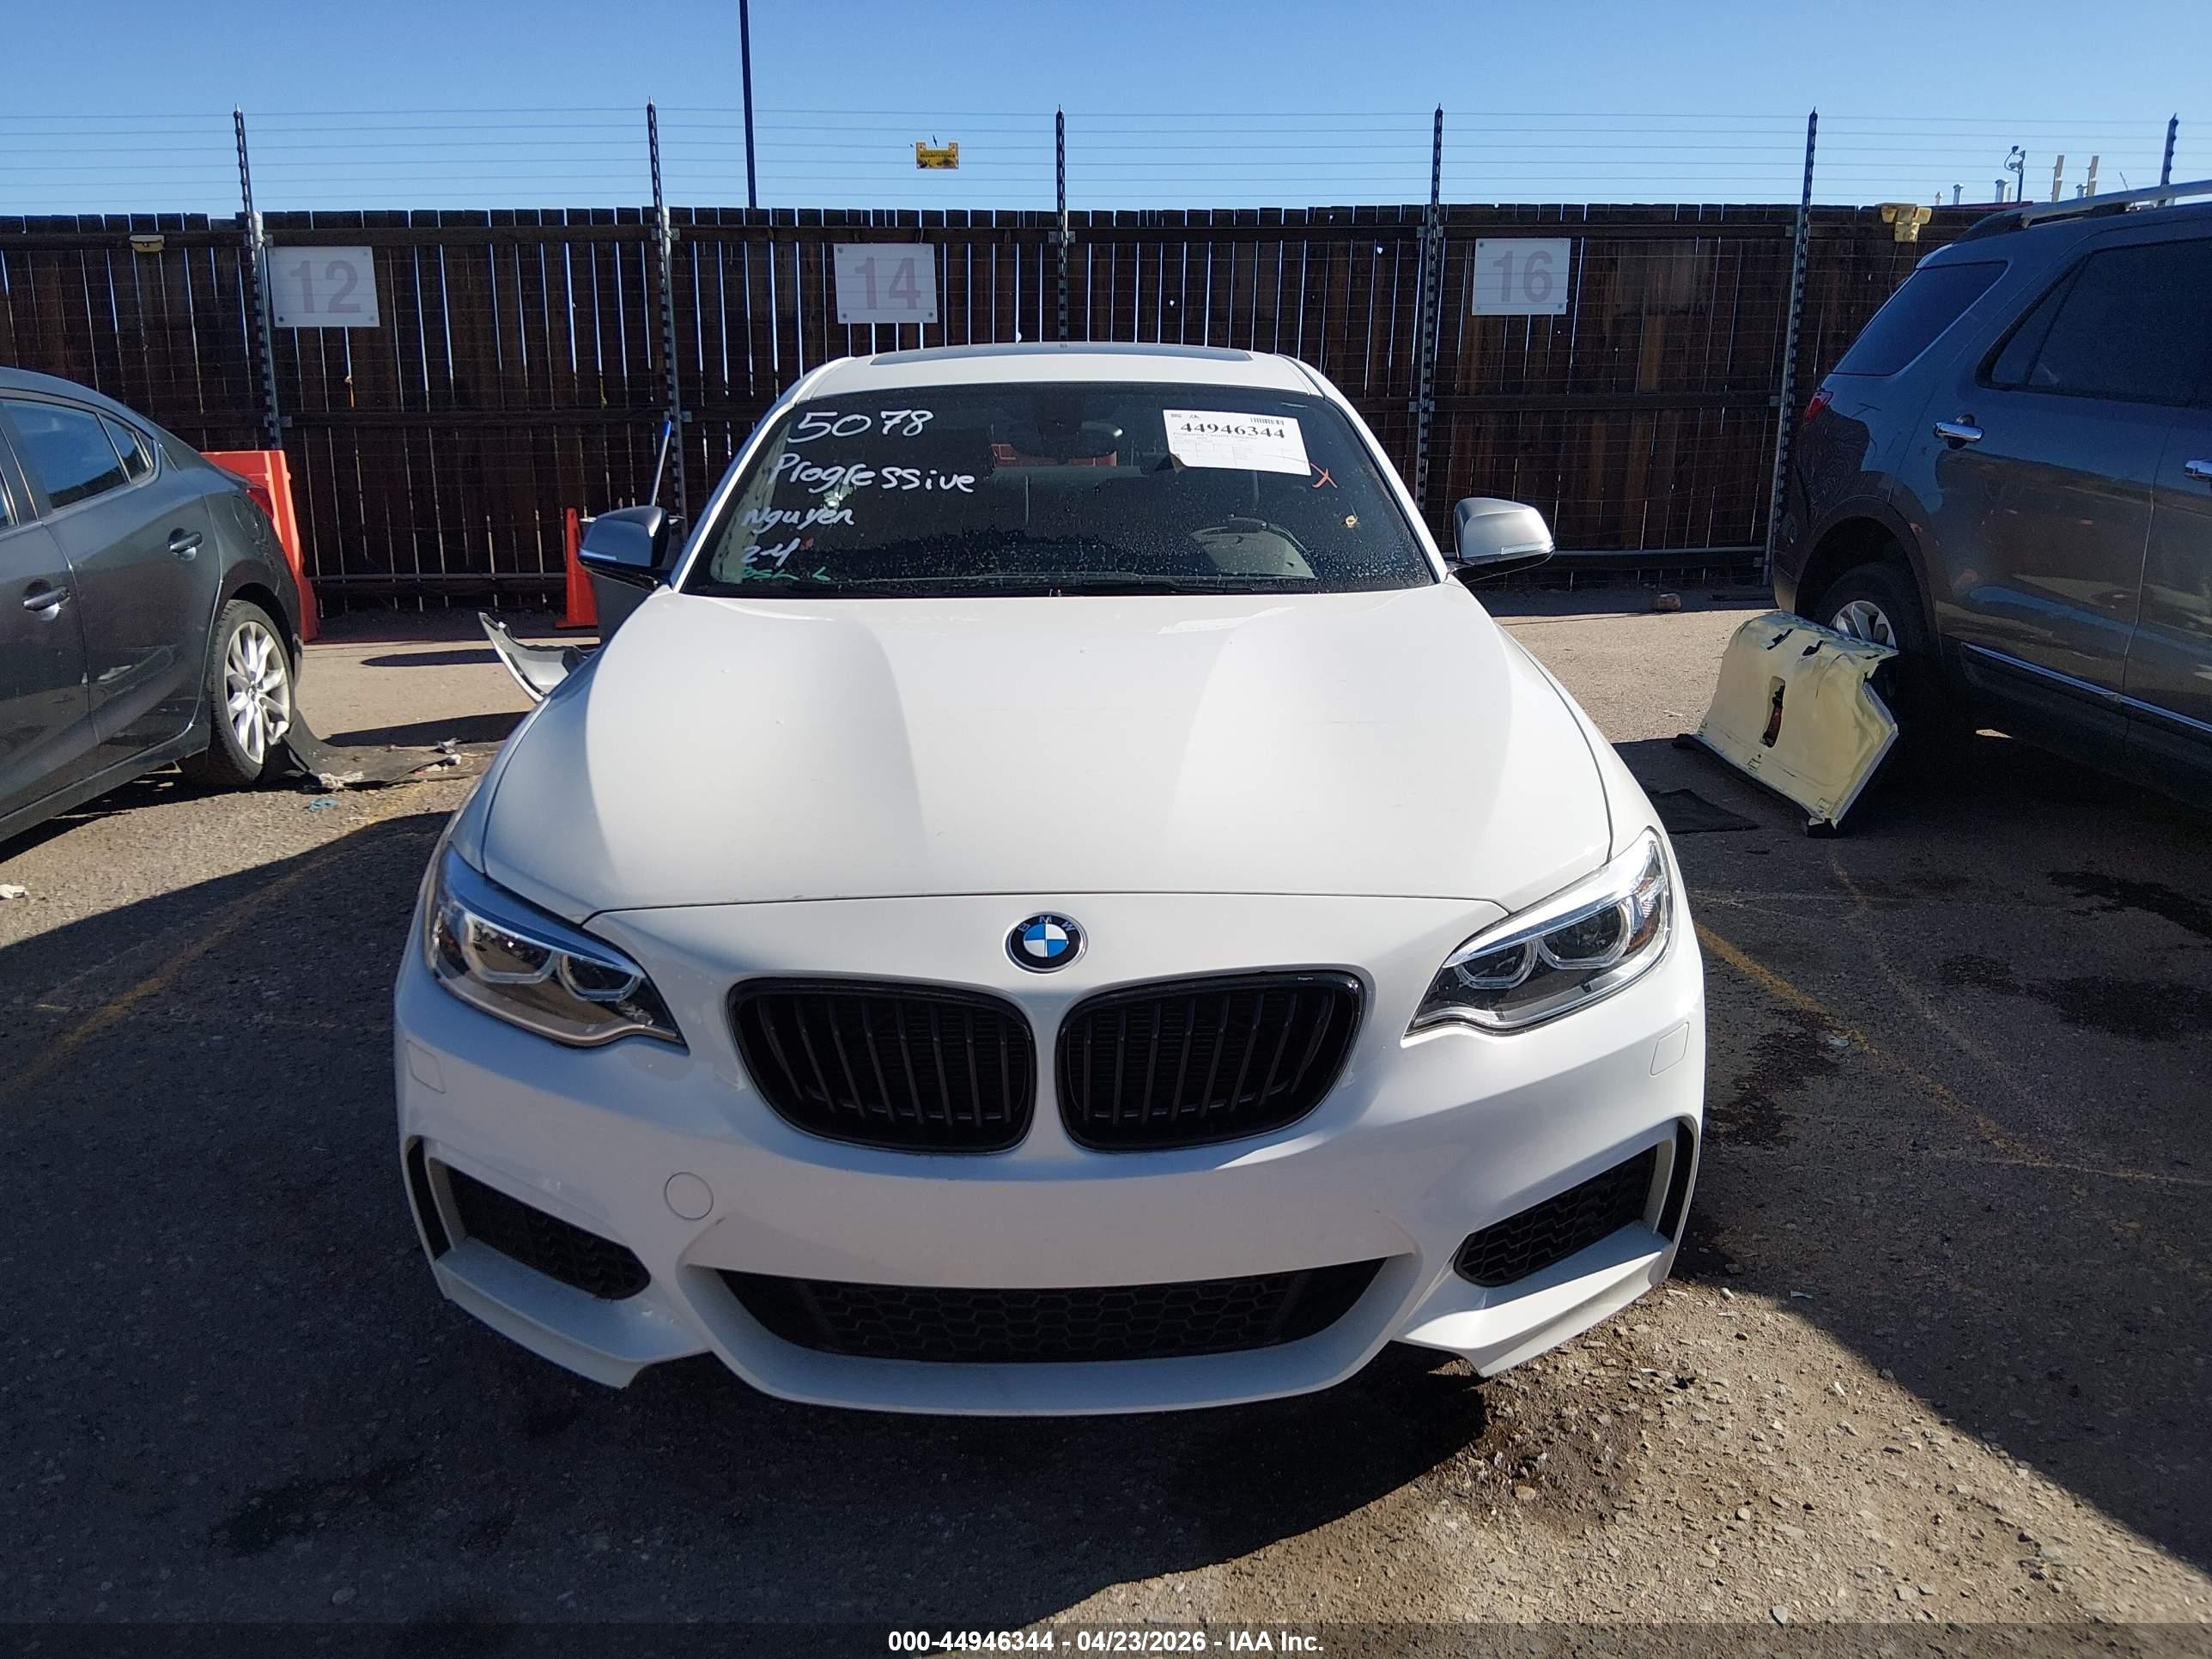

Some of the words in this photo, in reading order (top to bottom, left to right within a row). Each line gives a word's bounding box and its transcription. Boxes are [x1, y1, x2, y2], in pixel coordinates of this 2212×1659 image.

[289, 260, 362, 313] 12
[854, 257, 921, 310] 14
[1493, 250, 1553, 303] 16
[787, 410, 934, 443] 5078
[1181, 422, 1285, 439] 44946344
[767, 453, 975, 494] Progressive
[1018, 915, 1076, 933] BMW
